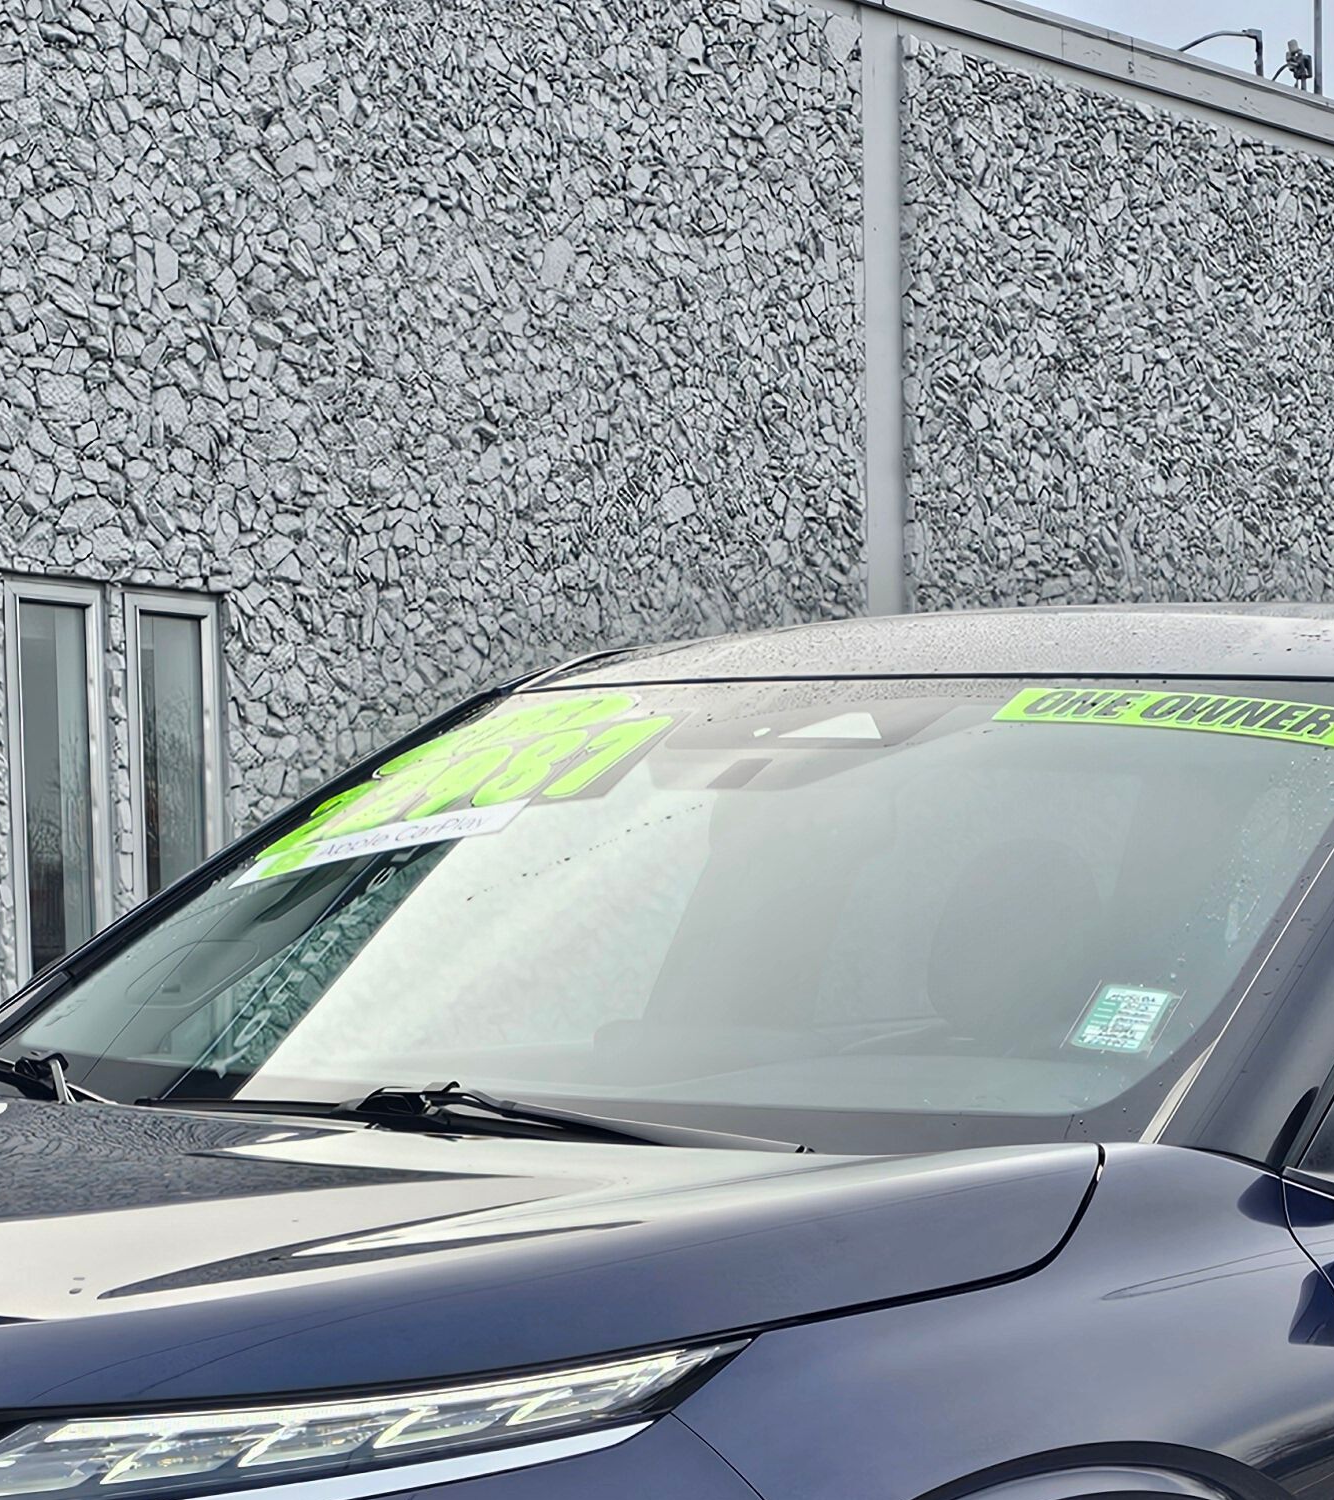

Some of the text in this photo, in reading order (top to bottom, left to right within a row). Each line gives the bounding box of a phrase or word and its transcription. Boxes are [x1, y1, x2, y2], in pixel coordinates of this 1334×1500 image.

[1022, 690, 1148, 719] ONE
[316, 814, 492, 859] Apple CarPlay
